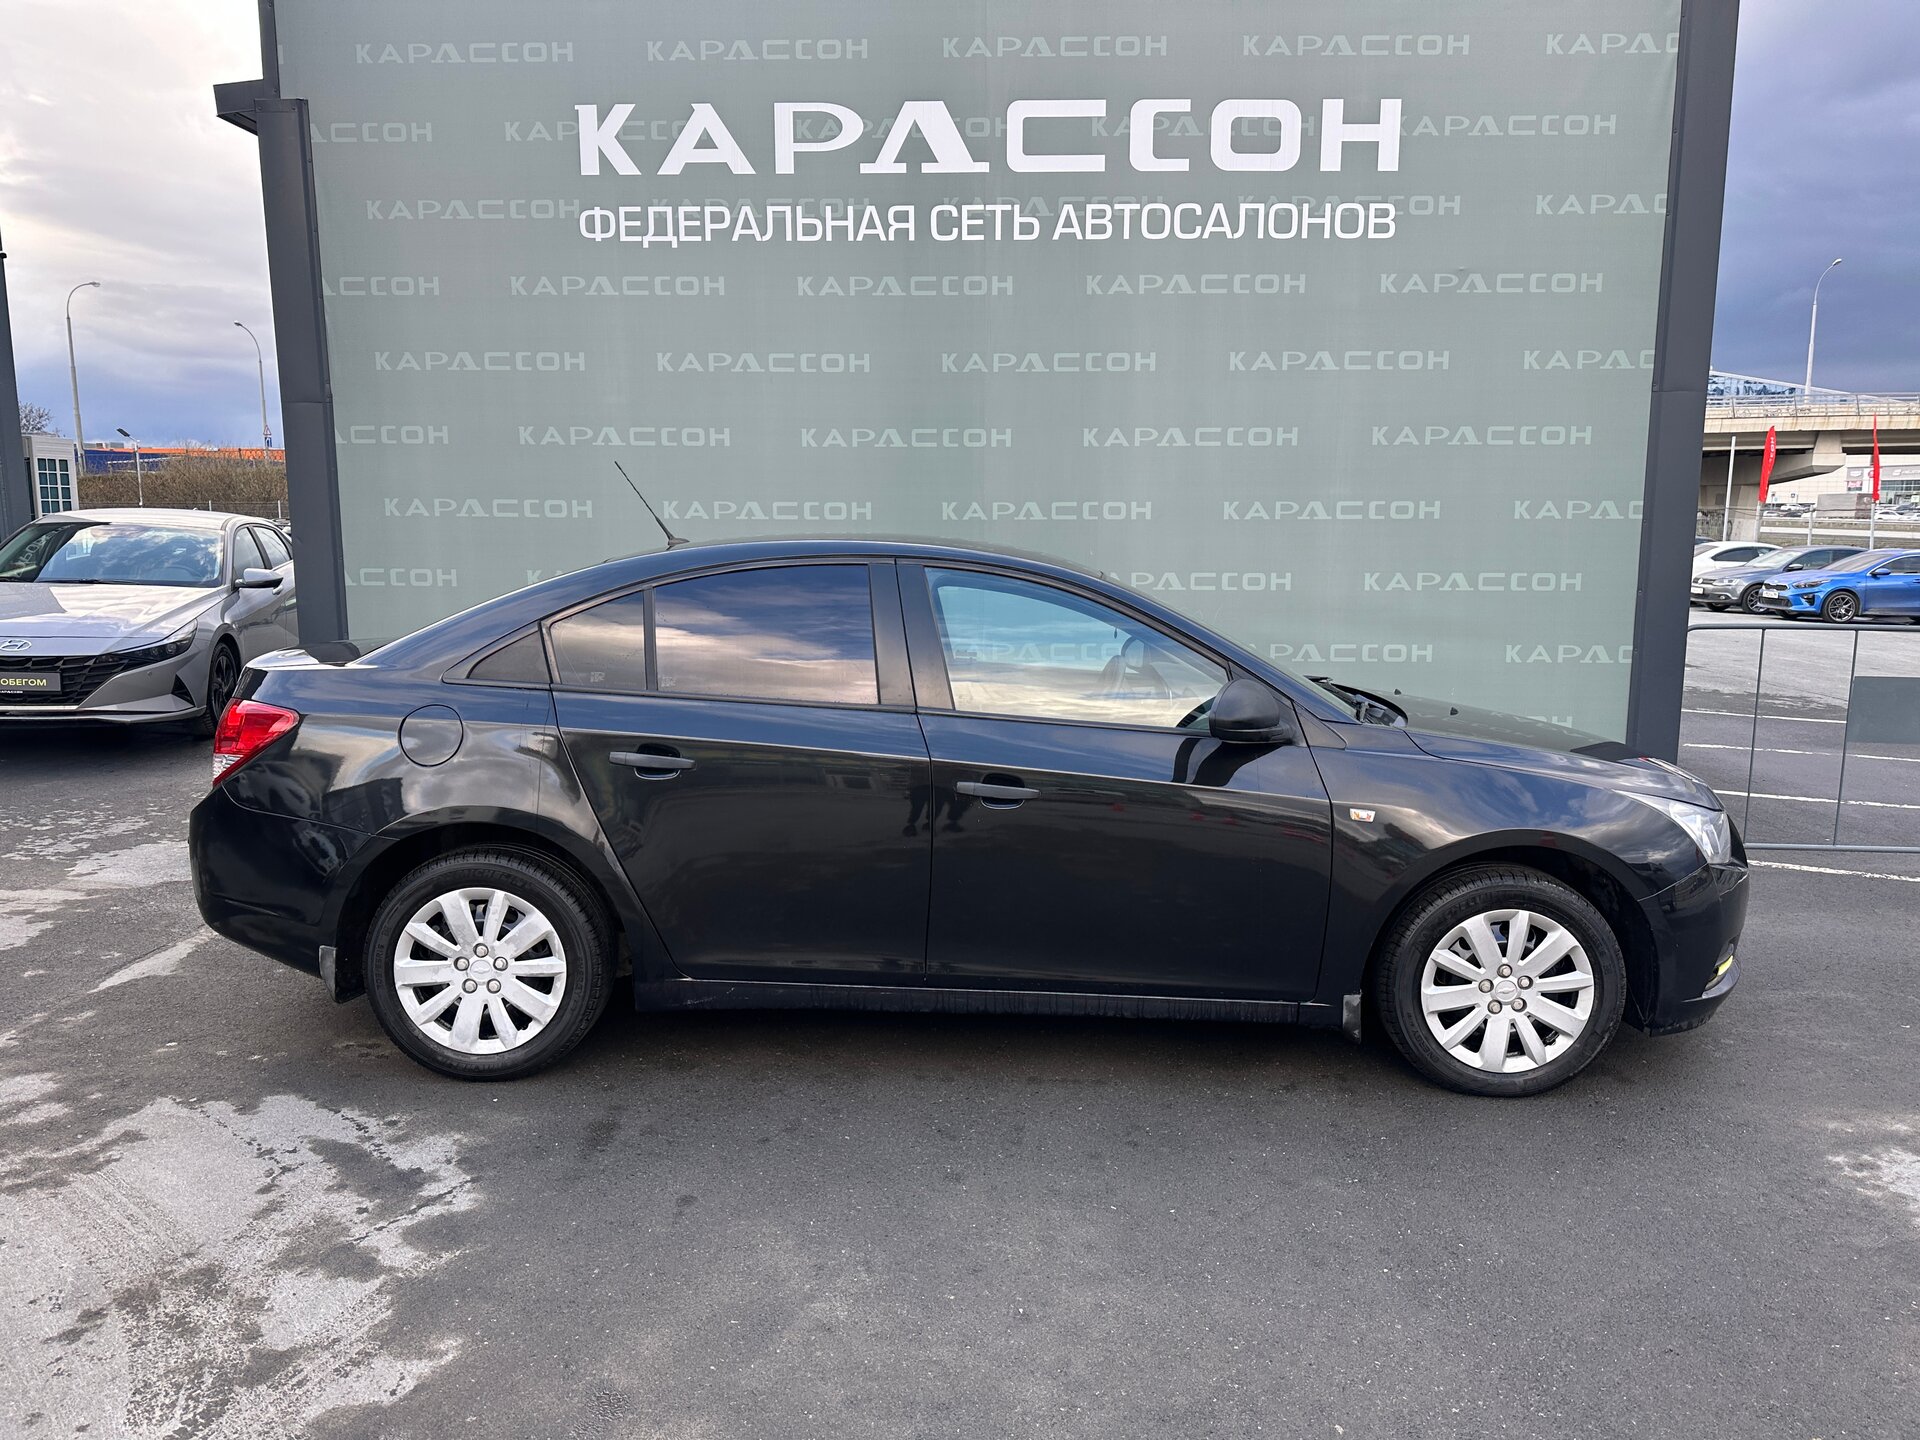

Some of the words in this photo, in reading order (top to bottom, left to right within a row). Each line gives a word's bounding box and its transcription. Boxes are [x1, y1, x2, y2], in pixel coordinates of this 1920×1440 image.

[579, 204, 916, 248] ФЕДЕРАЛЬНАЯ
[929, 203, 1041, 242] СЕТЬ
[1051, 202, 1397, 241] АВТОСАЛОНОВ
